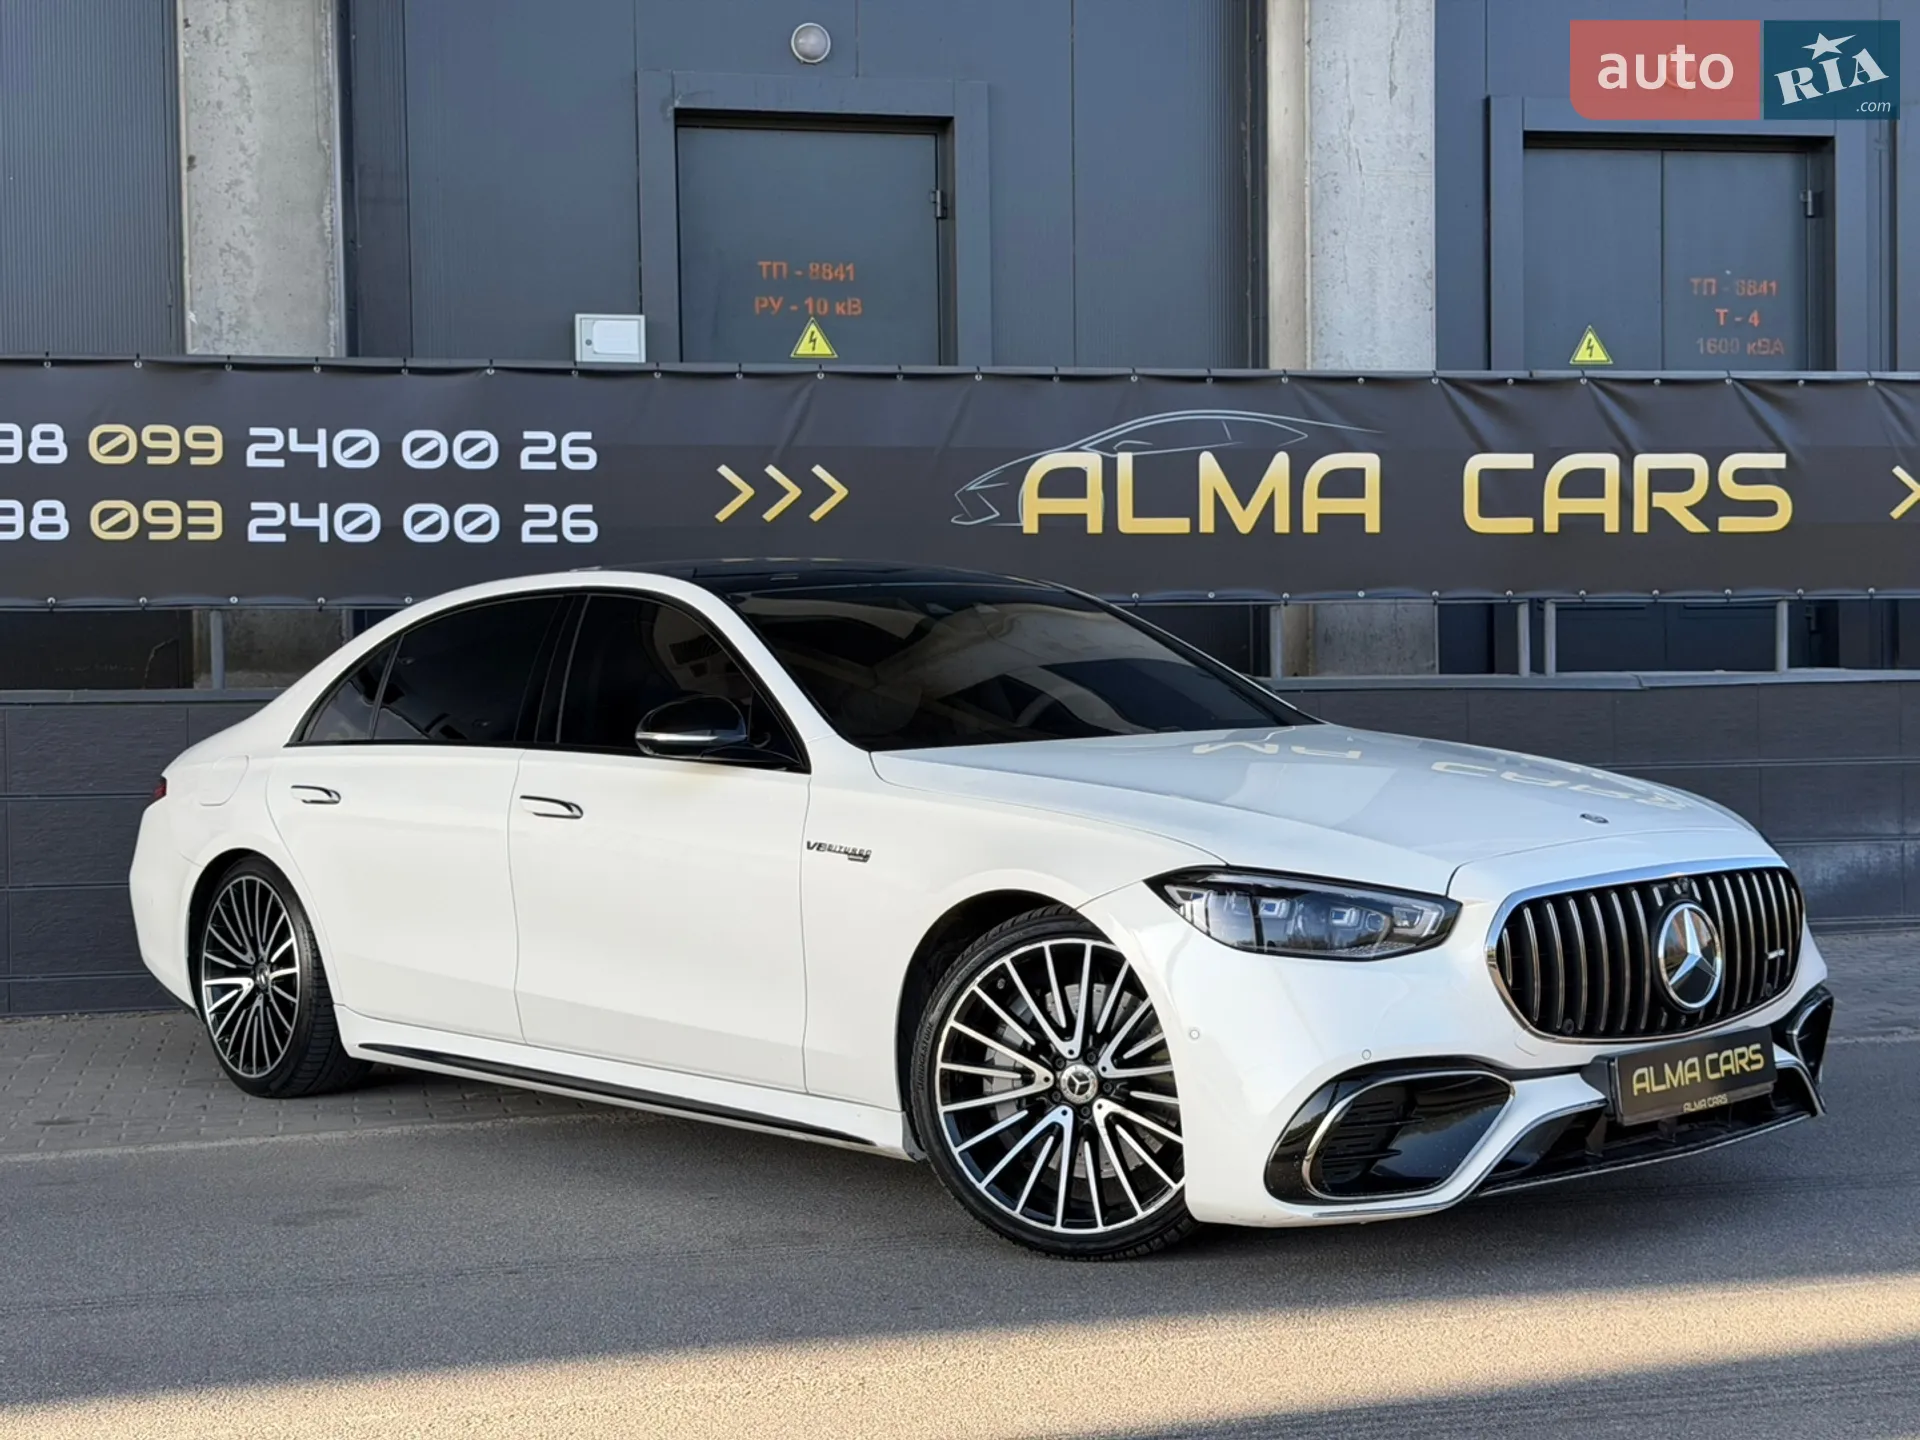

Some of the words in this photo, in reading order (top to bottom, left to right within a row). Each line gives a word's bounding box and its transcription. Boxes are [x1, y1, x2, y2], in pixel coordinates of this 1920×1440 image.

[757, 261, 788, 280] ТП
[809, 262, 856, 282] 8841
[1690, 278, 1717, 296] ТП
[754, 296, 784, 315] РУ
[804, 297, 829, 316] 10
[1715, 308, 1729, 326] Т
[1748, 309, 1761, 327] 4
[89, 423, 224, 466] 099
[246, 426, 380, 469] 240
[402, 429, 499, 470] 00
[520, 431, 598, 471] 26
[1022, 451, 1382, 534] ALMA
[1464, 452, 1793, 534] CARS
[90, 499, 223, 541] 093
[247, 501, 382, 543] 240
[403, 502, 500, 543] 00
[521, 503, 599, 543] 26
[1632, 1056, 1702, 1097] ALMA
[1705, 1043, 1765, 1080] CARS
[1682, 1098, 1707, 1113] ALMA
[1706, 1093, 1729, 1109] CARS
